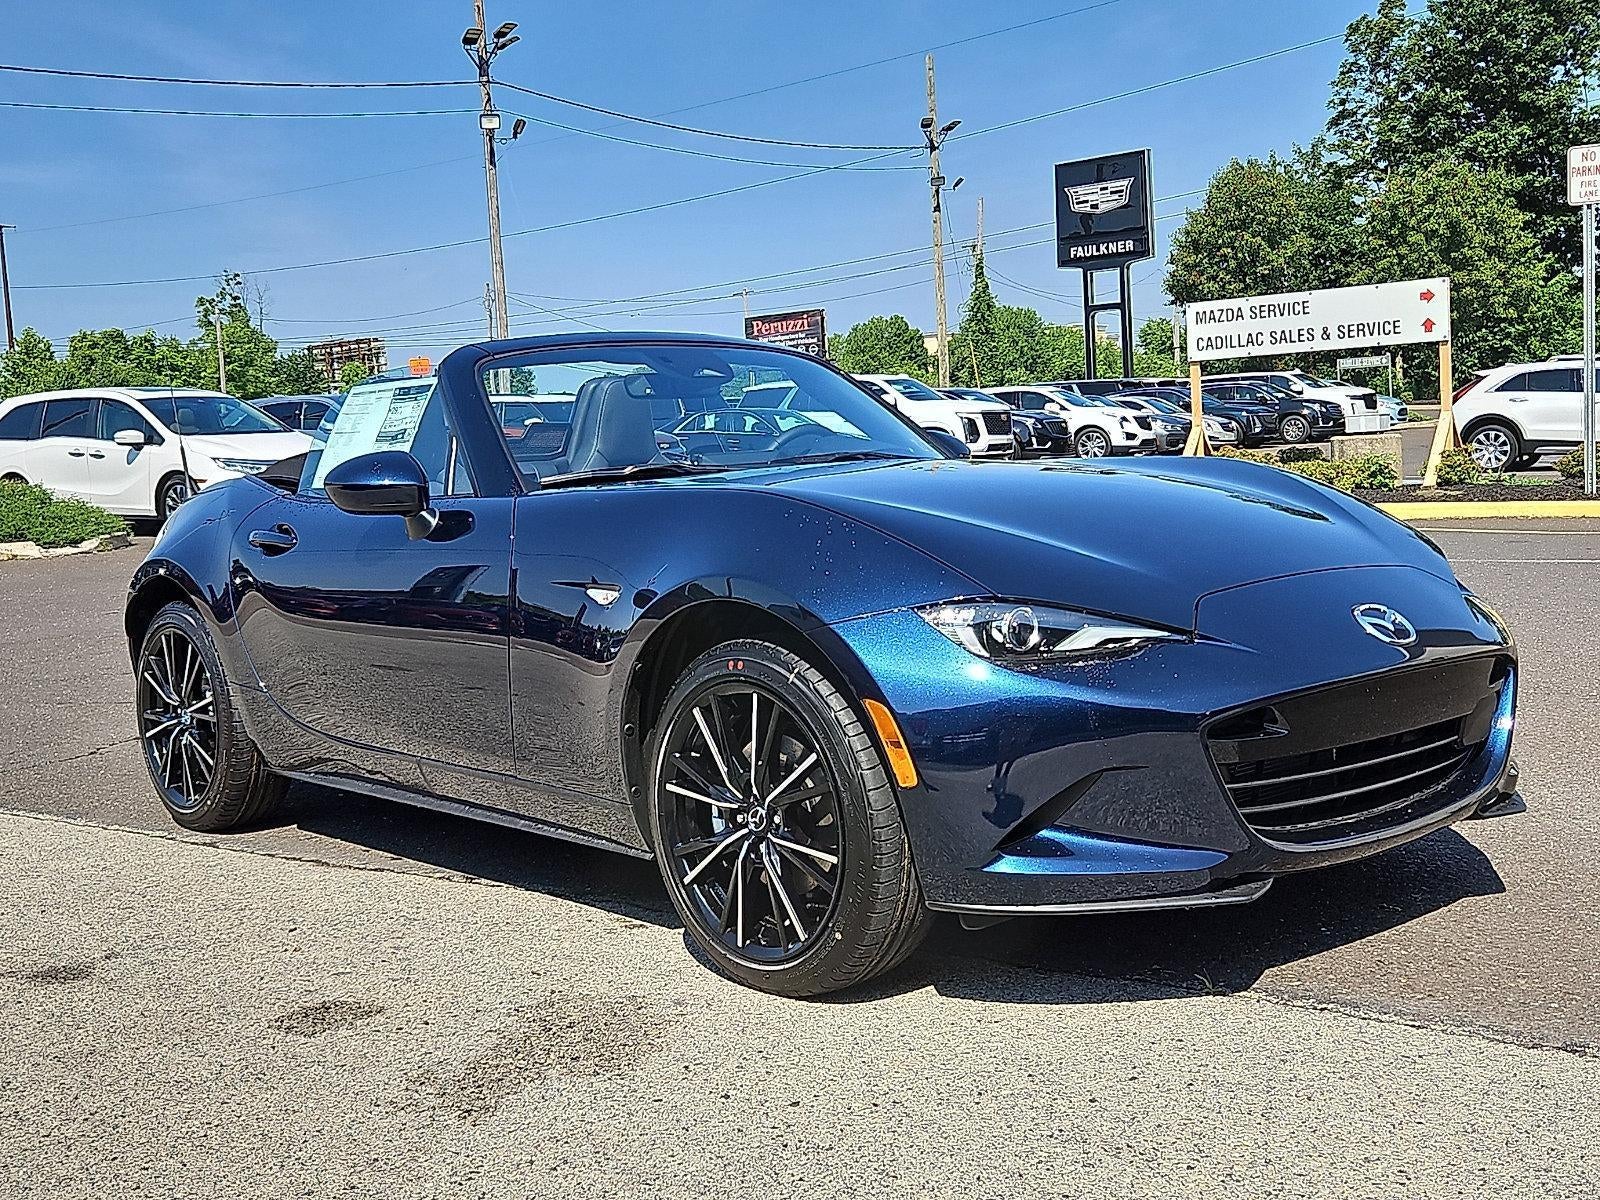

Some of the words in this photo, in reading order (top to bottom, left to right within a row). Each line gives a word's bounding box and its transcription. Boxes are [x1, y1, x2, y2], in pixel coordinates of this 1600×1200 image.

[1582, 151, 1596, 161] NO
[1572, 165, 1600, 177] PARKIN
[1581, 180, 1597, 188] FIRE
[1580, 190, 1598, 198] LANE
[1070, 240, 1133, 258] FAULKNER
[1194, 306, 1244, 326] MAZDA
[1249, 300, 1311, 321] SERVICE
[752, 314, 808, 335] Peruzzi
[1196, 331, 1265, 352] CADILLAC
[1269, 326, 1316, 345] SALES
[1320, 325, 1332, 341] &
[1337, 319, 1402, 339] SERVICE
